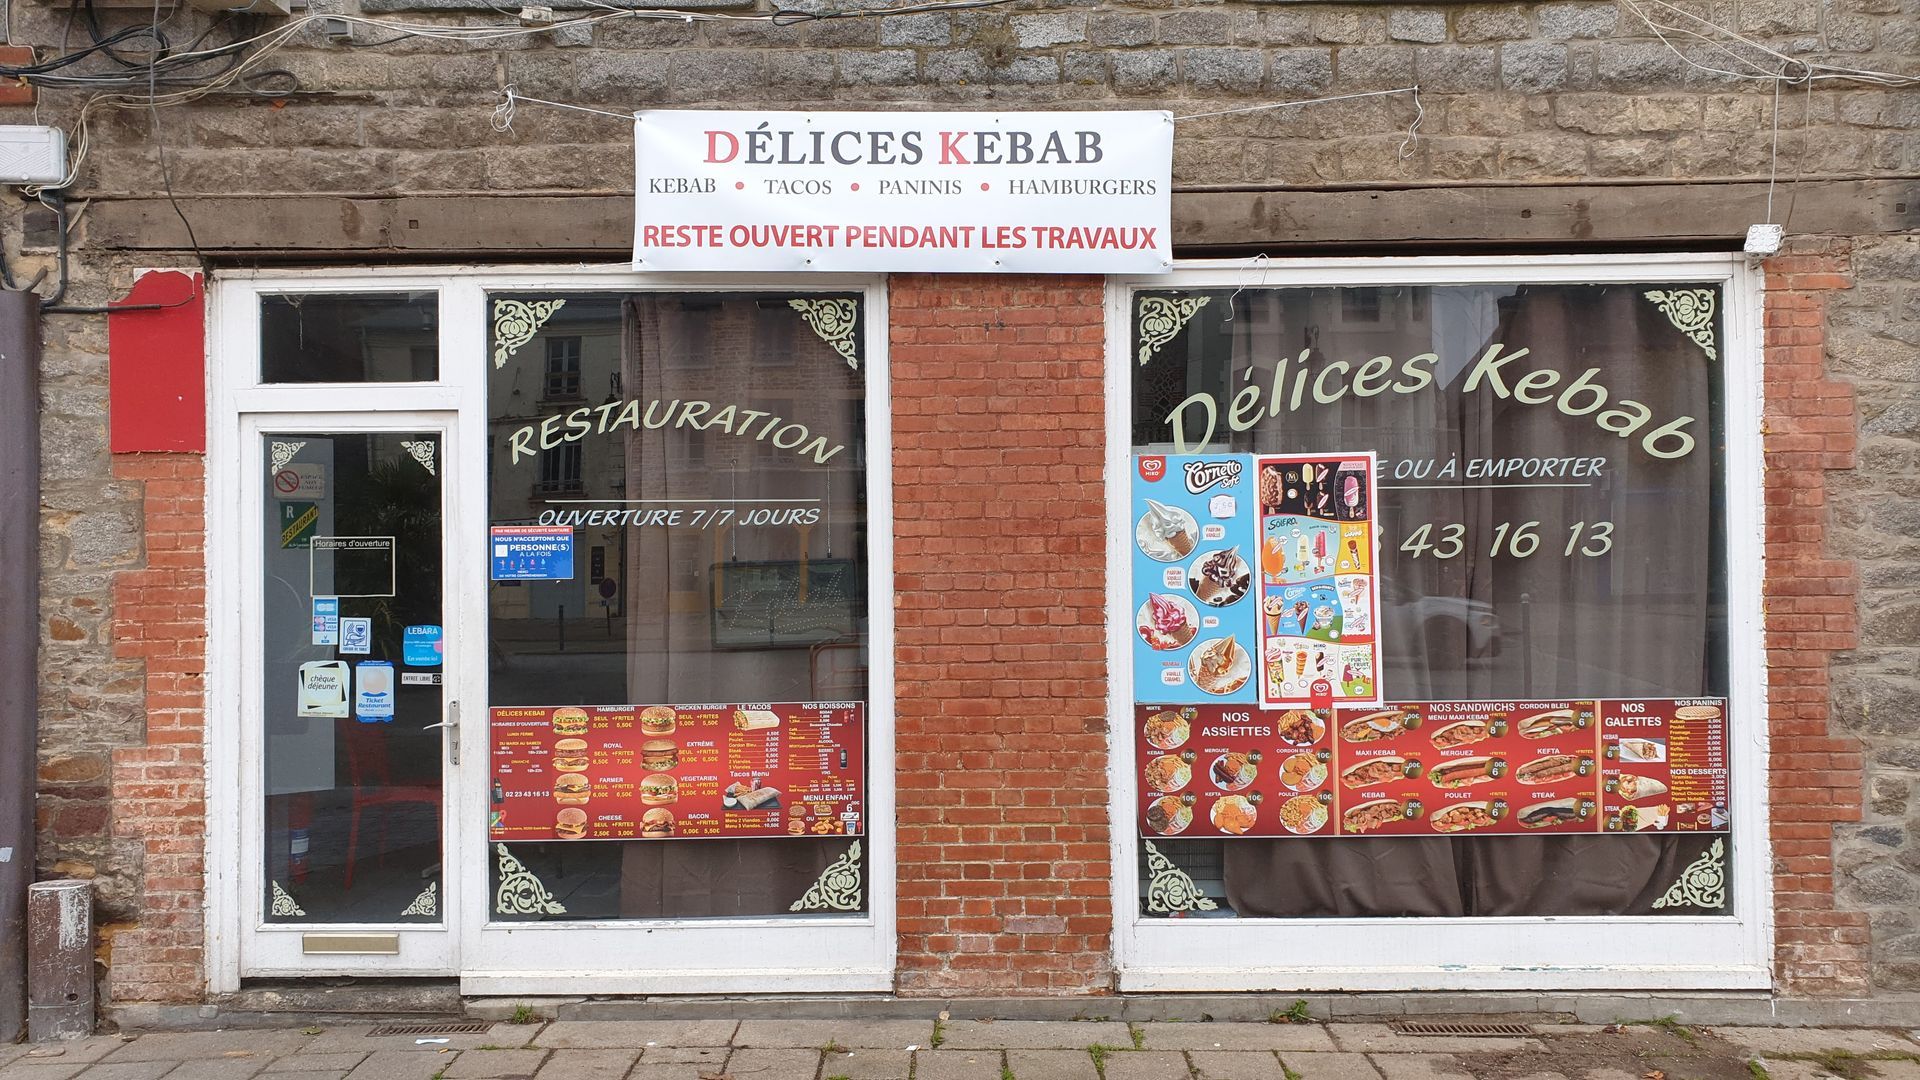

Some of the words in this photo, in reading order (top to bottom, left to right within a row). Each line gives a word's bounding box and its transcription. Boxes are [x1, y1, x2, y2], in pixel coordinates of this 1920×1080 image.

[703, 122, 923, 165] DÉLICES
[937, 129, 1104, 165] KEBAB
[648, 177, 717, 194] KEBAB
[763, 178, 833, 196] TACOS
[878, 178, 963, 196] PANINIS
[1008, 178, 1157, 196] HAMBURGERS
[643, 224, 725, 248] RESTE
[729, 224, 840, 249] OUVERT
[845, 225, 976, 249] PENDANT
[981, 226, 1027, 250] LES
[1035, 226, 1157, 250] TRAVAUX
[1164, 347, 1440, 454] Délices
[1462, 342, 1697, 460] Kebab
[508, 399, 845, 465] RESTAURATION
[1394, 459, 1435, 479] OU
[1465, 456, 1607, 479] EMPORTER
[1182, 460, 1243, 495] Cornetto
[1220, 475, 1240, 489] Soft
[286, 505, 294, 519] R
[537, 509, 682, 527] OUVERTURE
[690, 509, 738, 530] 7/7
[739, 508, 822, 526] JOURS
[281, 508, 318, 542] RESTAURANT
[315, 540, 347, 548] Horaires
[1400, 522, 1466, 559] 43
[1490, 521, 1541, 558] 16
[1563, 521, 1615, 558] 13
[509, 544, 570, 552] PERSONNE(S)
[408, 627, 438, 635] LEBARA
[310, 674, 336, 683] chèque
[307, 682, 338, 692] déjeuner
[1429, 703, 1452, 713] NOS
[1453, 702, 1516, 712] SANDWICHS
[1621, 703, 1645, 713] NOS
[1222, 712, 1250, 722] NOS
[1404, 717, 1409, 725] 7
[1578, 718, 1585, 726] 6
[1605, 717, 1662, 727] GALETTES
[1490, 726, 1496, 735] 8
[1404, 766, 1410, 774] 7
[1492, 768, 1499, 776] 6
[1579, 766, 1586, 774] 6
[1605, 784, 1611, 792] 6
[1318, 793, 1332, 801] 10€
[846, 804, 853, 812] 6
[1406, 808, 1413, 816] 6
[1492, 808, 1499, 817] 6
[1580, 807, 1587, 816] 6
